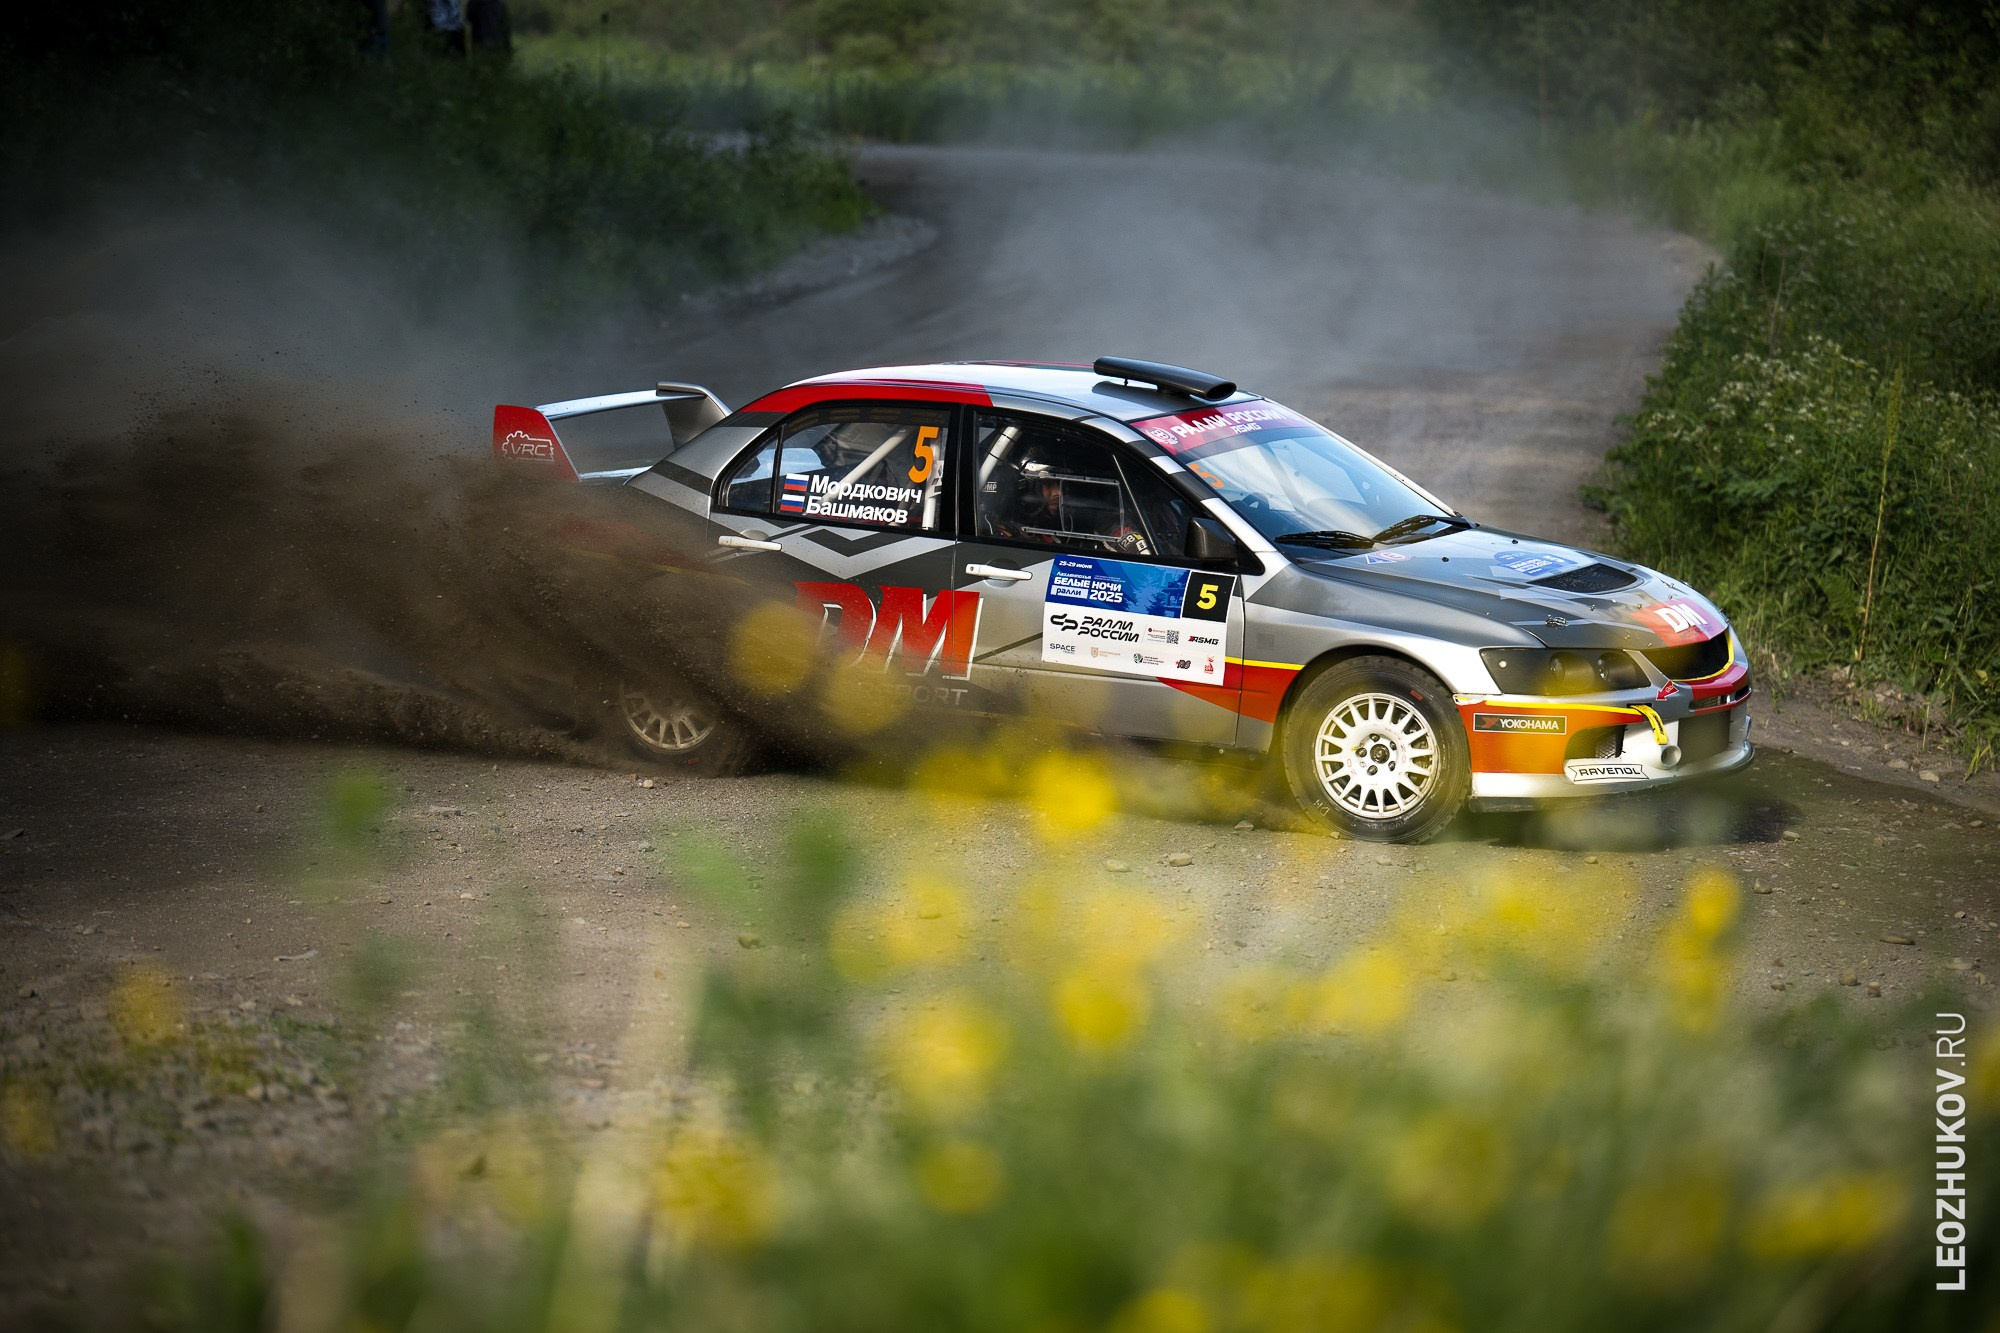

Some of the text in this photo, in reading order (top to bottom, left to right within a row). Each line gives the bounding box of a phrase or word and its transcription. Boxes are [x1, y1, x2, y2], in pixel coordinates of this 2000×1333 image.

[1170, 414, 1227, 438] РАЛЛИ
[511, 443, 548, 456] VRC
[907, 426, 939, 483] 5
[810, 474, 922, 504] Мордкович
[806, 495, 908, 524] Башмаков
[1054, 576, 1091, 588] БЕЛЫЕ
[1091, 581, 1122, 592] НОЧИ
[1089, 590, 1124, 603] 2025
[1196, 583, 1219, 610] 5
[1083, 615, 1134, 631] РАЛЛИ
[1653, 603, 1709, 633] DM
[793, 581, 984, 681] DM
[1077, 626, 1140, 643] РОССИИ
[1049, 643, 1076, 652] SPACE
[1500, 718, 1559, 730] YOKOHAMA
[1579, 767, 1641, 777] RAVENOL
